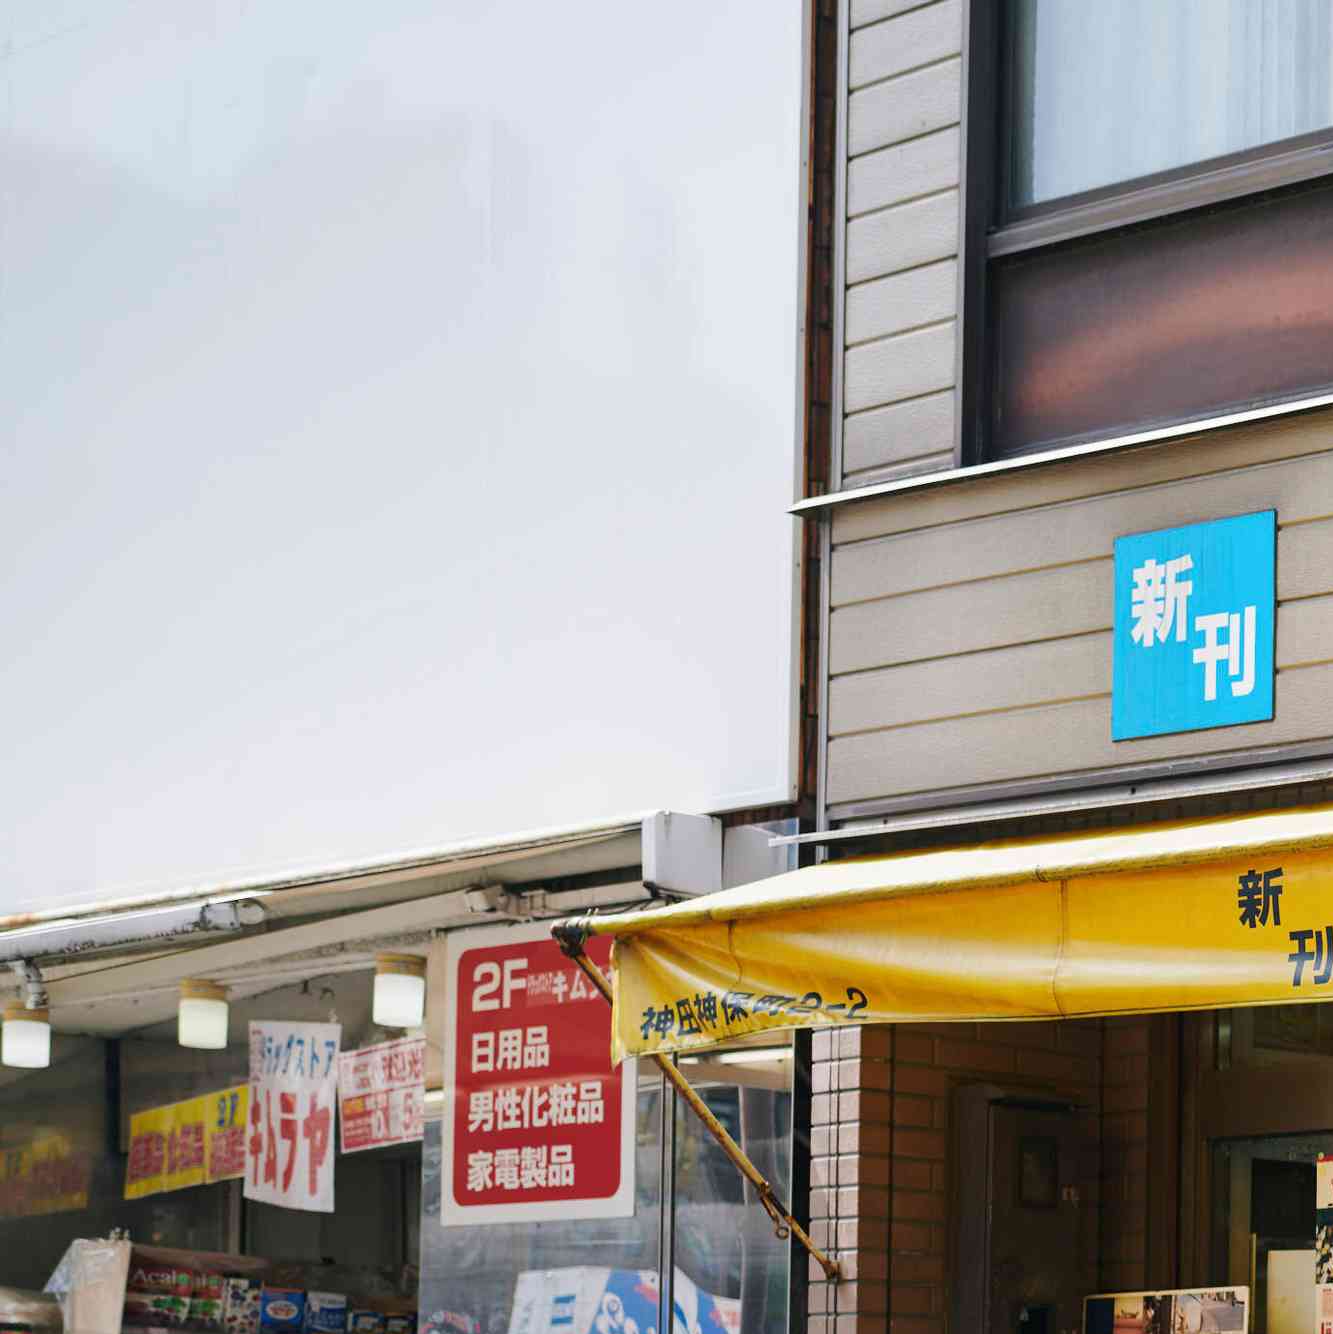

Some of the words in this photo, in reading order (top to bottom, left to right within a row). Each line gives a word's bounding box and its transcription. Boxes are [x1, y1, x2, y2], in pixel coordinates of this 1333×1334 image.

[472, 958, 528, 1012] 2F
[471, 1026, 550, 1073] 日用品
[468, 1081, 605, 1132] 男性化粧品
[249, 1084, 331, 1196] キムラヤ
[466, 1145, 575, 1191] 家電製品
